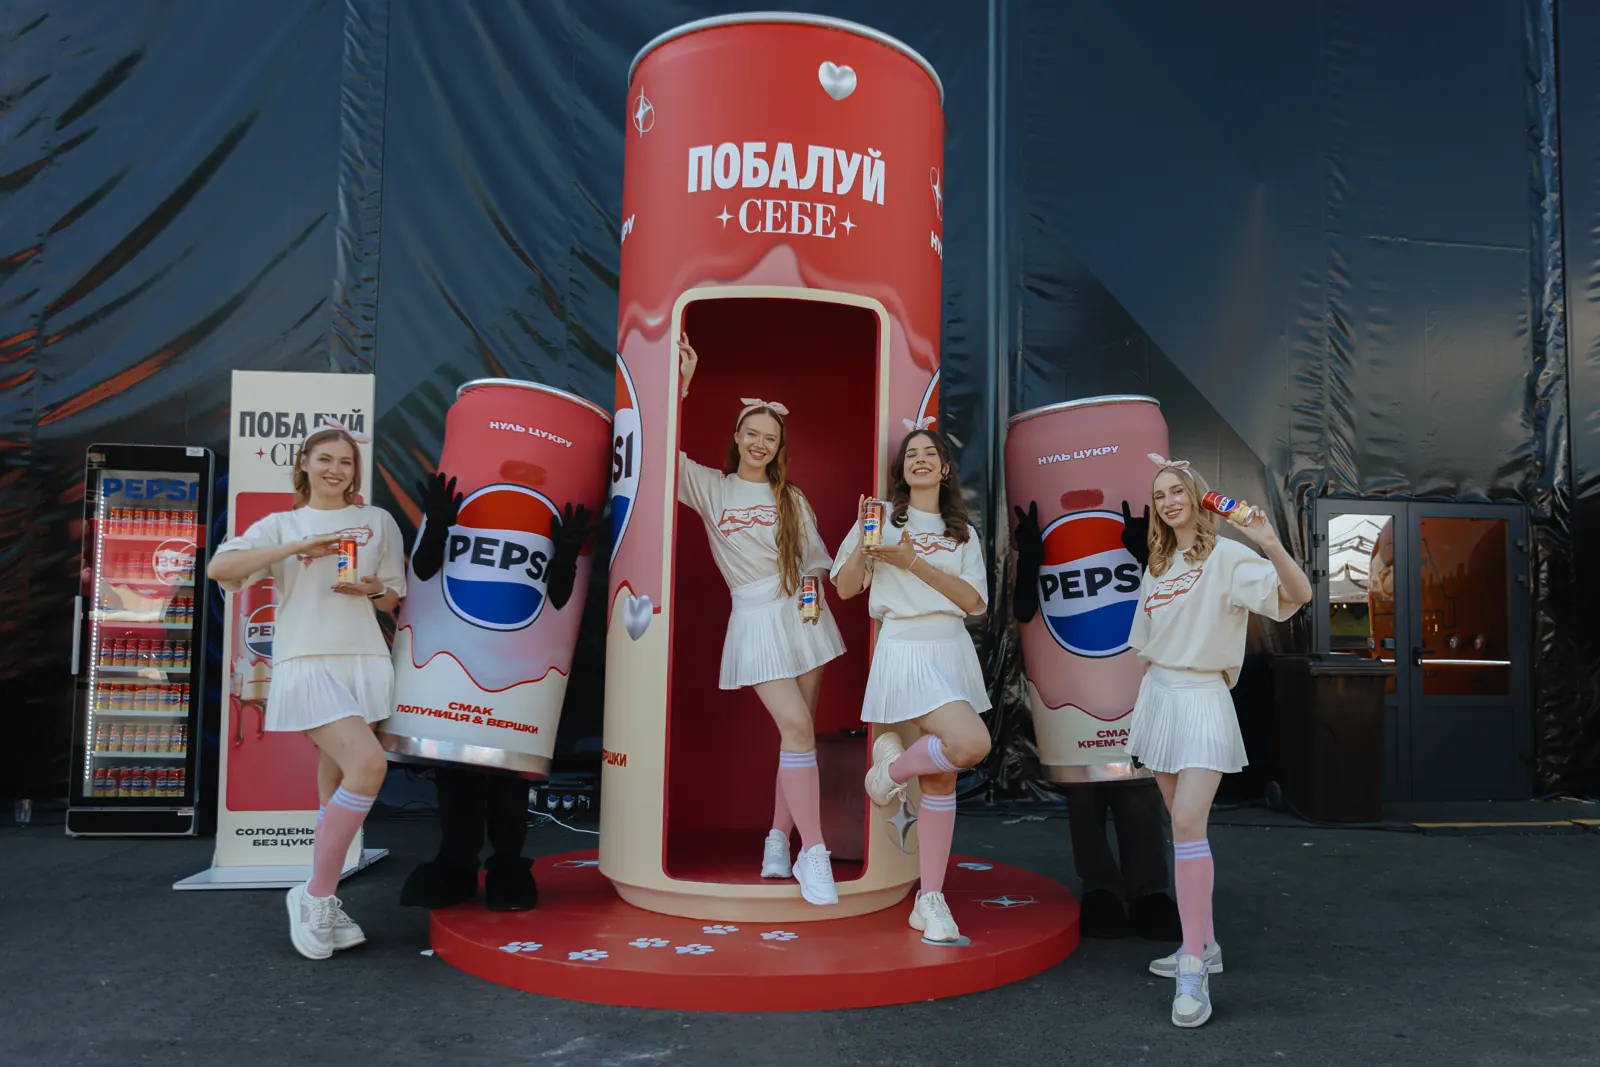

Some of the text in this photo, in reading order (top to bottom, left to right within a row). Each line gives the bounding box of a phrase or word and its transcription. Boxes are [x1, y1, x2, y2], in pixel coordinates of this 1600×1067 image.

[687, 142, 886, 206] ПОБАЛУЙ
[738, 199, 837, 239] СЕБЕ
[489, 421, 573, 448] НУЛЬ ЦУКРУ
[1037, 445, 1119, 466] НУЛЬ ЦУКРУ
[103, 478, 199, 500] PEPSI
[1039, 563, 1140, 601] PEPS
[448, 701, 494, 716] СМАК
[396, 704, 539, 735] ПОЛУНИЦЯ & ВЕРШКИ
[1077, 738, 1129, 749] КРЕМ-С
[602, 748, 627, 768] РШКИ
[235, 827, 315, 837] СОЛОДЕНЬ
[252, 838, 316, 847] БЕЗ ЦУКР
